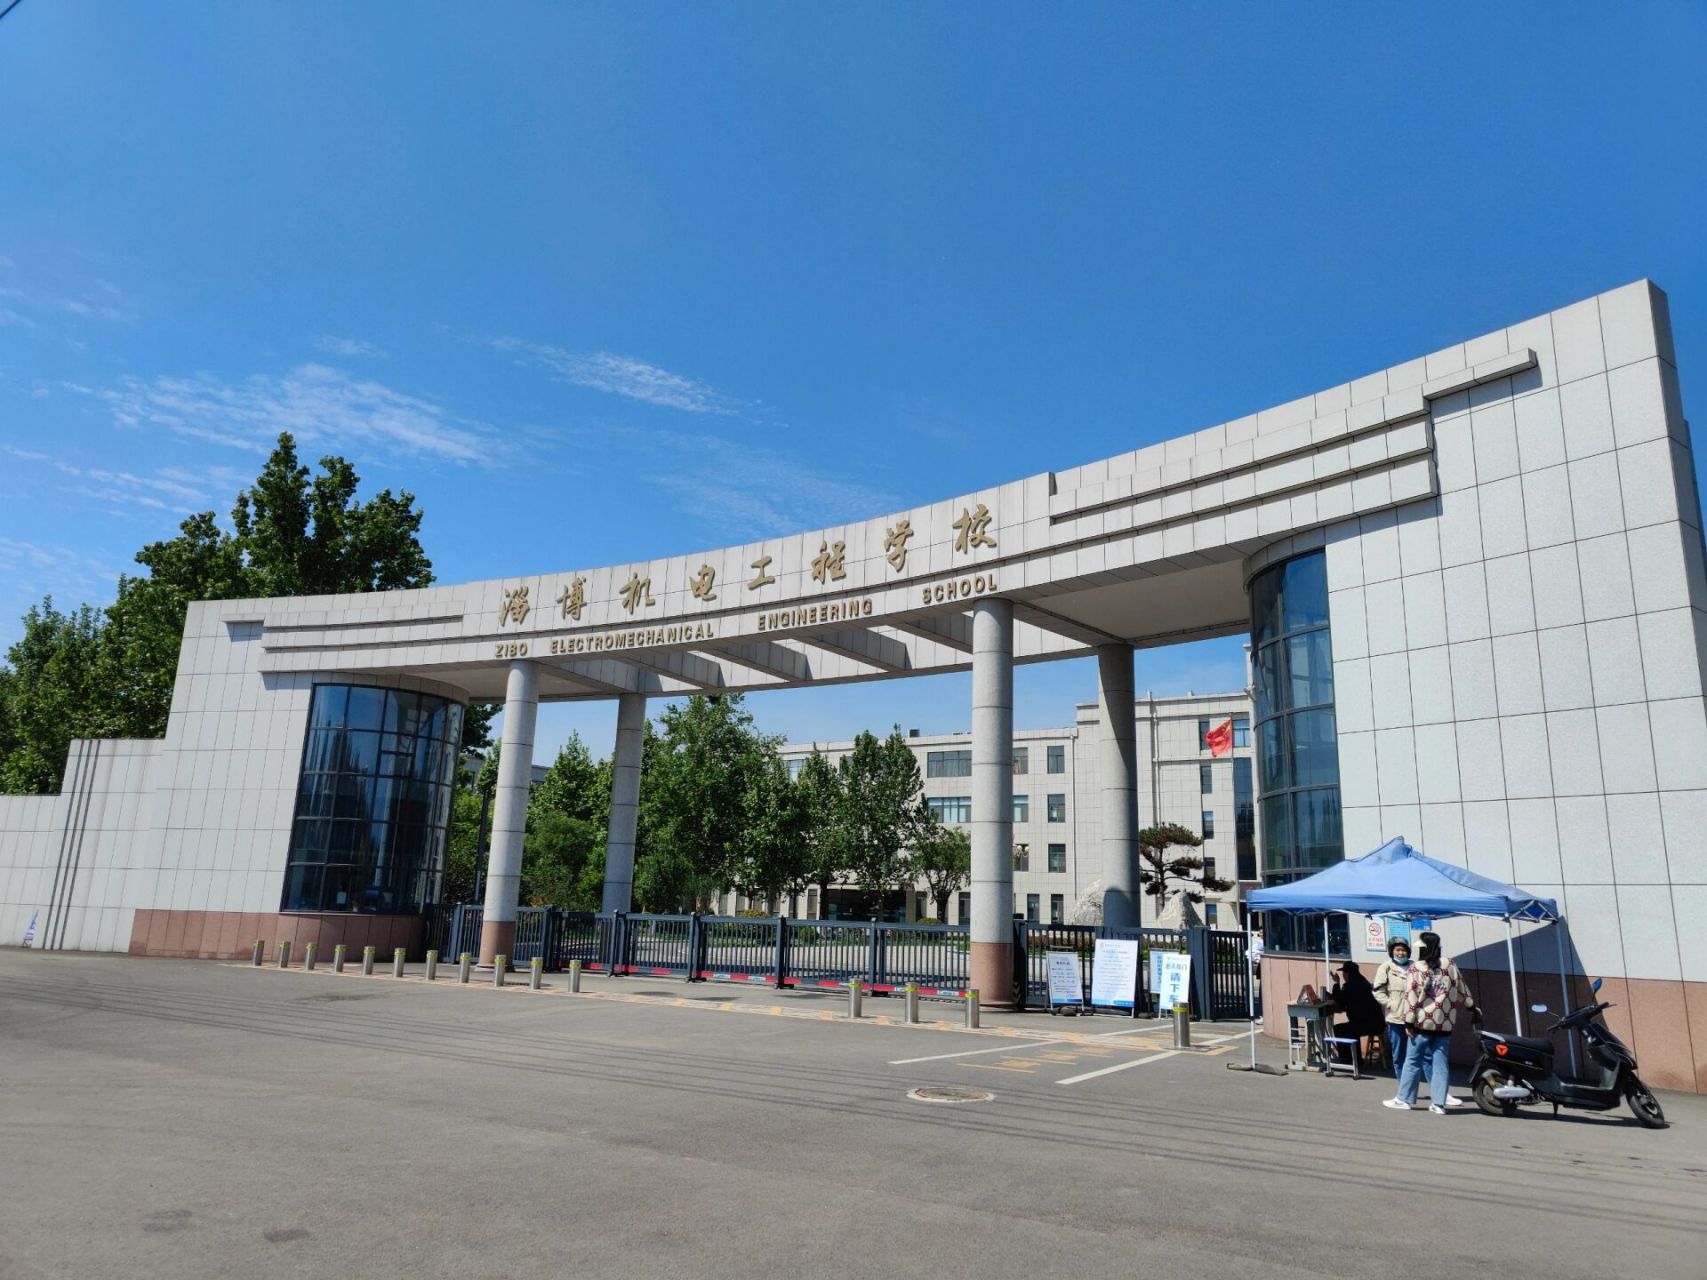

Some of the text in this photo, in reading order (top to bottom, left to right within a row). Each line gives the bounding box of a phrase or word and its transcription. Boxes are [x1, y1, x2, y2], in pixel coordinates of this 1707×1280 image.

[496, 574, 997, 658] ZIBO ELECTROMECHANICAL ENGINEERING SCHOOL
[500, 505, 997, 626] 淄博机电工程学校
